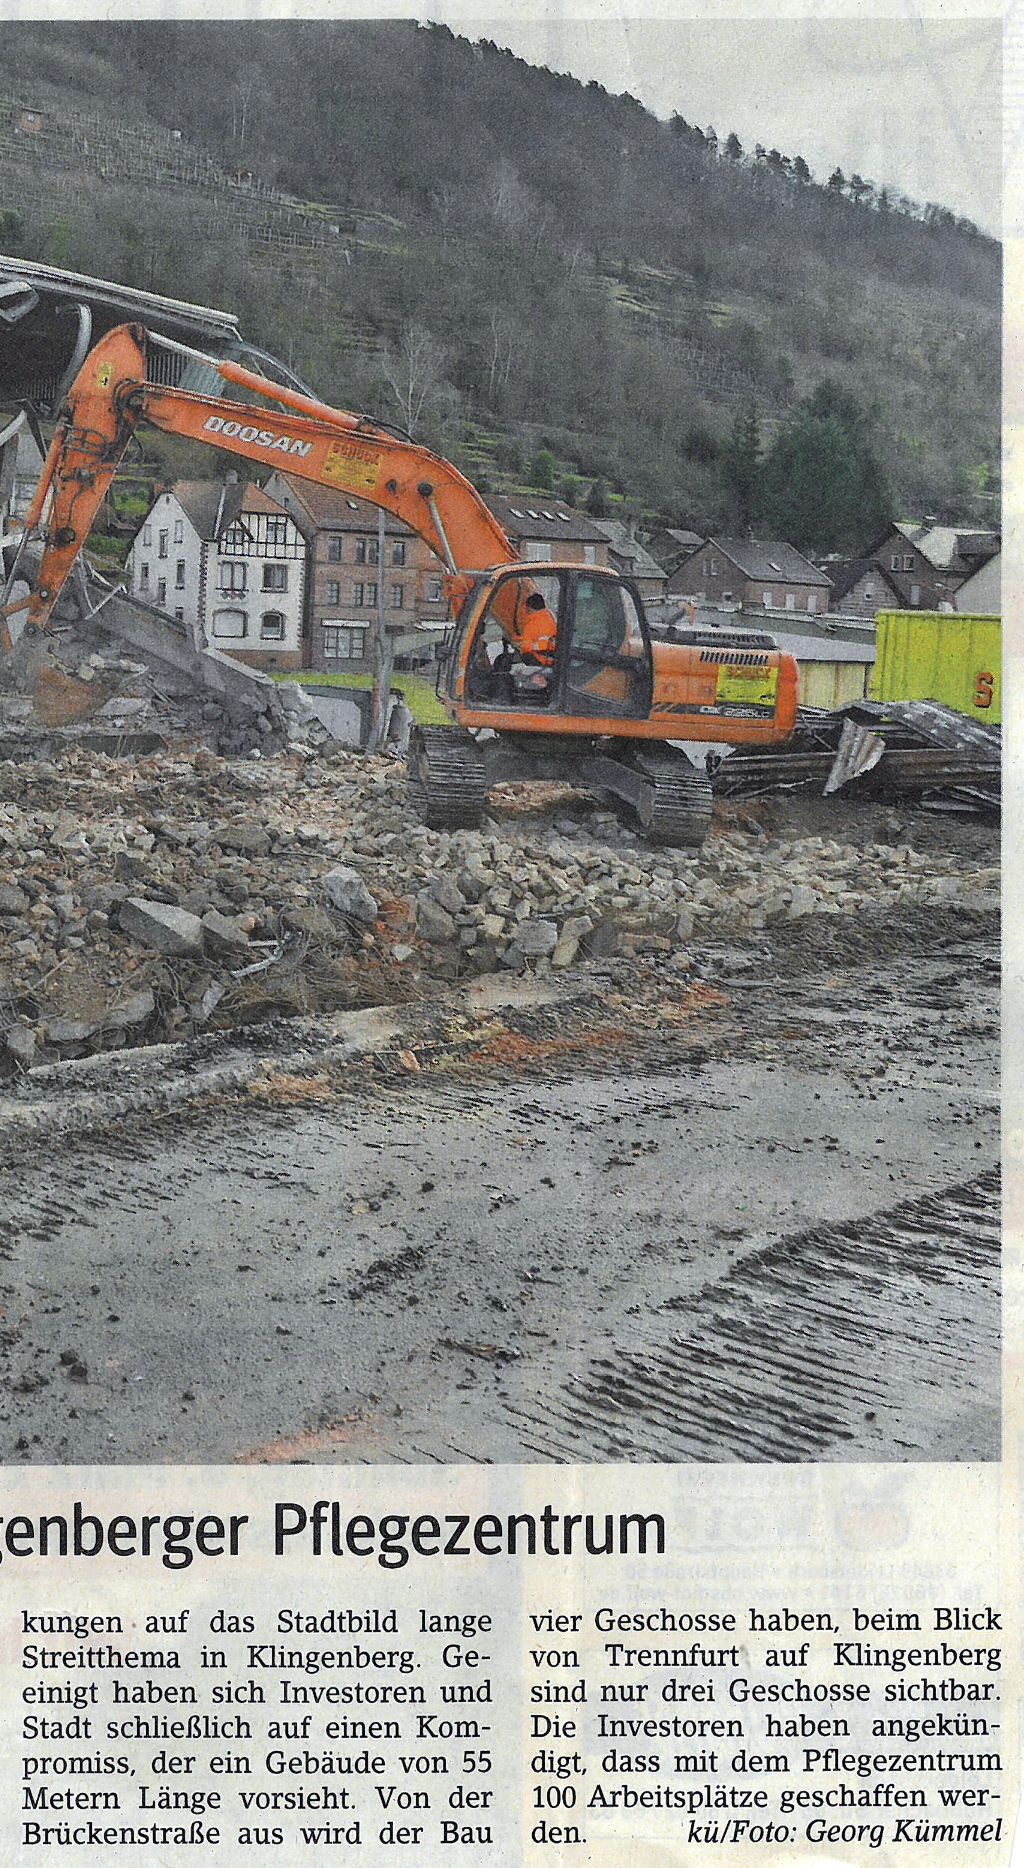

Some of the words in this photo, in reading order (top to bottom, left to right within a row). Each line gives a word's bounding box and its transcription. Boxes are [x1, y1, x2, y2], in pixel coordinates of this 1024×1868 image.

[203, 414, 314, 458] DOOSAN
[274, 1500, 665, 1570] Pflegezentrum
[21, 1609, 124, 1639] kungen
[145, 1609, 190, 1634] auf
[209, 1609, 255, 1634] das
[277, 1609, 399, 1634] Stadtbild
[419, 1609, 492, 1638] lange
[528, 1609, 583, 1633] vier
[594, 1607, 736, 1632] Geschosse
[748, 1607, 840, 1634] haben,
[852, 1607, 922, 1632] beim
[933, 1607, 1003, 1631] Blick
[22, 1644, 181, 1669] Streitthema
[200, 1645, 228, 1668] in
[246, 1645, 423, 1675] Klingenberg.
[442, 1643, 491, 1668] Ge-
[529, 1650, 580, 1668] von
[604, 1642, 740, 1667] Trennfurt
[765, 1642, 810, 1667] auf
[833, 1642, 1002, 1672] Klingenberg
[22, 1680, 99, 1710] einigt
[112, 1680, 198, 1704] haben
[212, 1679, 266, 1704] sich
[279, 1680, 427, 1704] Investoren
[439, 1679, 493, 1704] und
[530, 1679, 588, 1703] sind
[600, 1684, 649, 1702] nur
[661, 1678, 716, 1702] drei
[729, 1678, 871, 1703] Geschosse
[884, 1678, 1003, 1702] sichtbar.
[22, 1715, 92, 1740] Stadt
[107, 1714, 253, 1739] schließlich
[267, 1715, 312, 1739] auf
[325, 1715, 402, 1739] einen
[416, 1715, 491, 1739] Kom-
[530, 1714, 576, 1738] Die
[597, 1714, 745, 1738] Investoren
[765, 1713, 851, 1738] haben
[871, 1712, 1001, 1743] angekün-
[21, 1750, 136, 1781] promiss,
[151, 1750, 196, 1774] der
[209, 1750, 253, 1774] ein
[265, 1750, 386, 1775] Gebäude
[398, 1756, 449, 1774] von
[462, 1750, 492, 1774] 55
[530, 1749, 587, 1780] digt,
[601, 1748, 660, 1773] dass
[673, 1749, 719, 1773] mit
[731, 1749, 791, 1773] dem
[802, 1748, 1003, 1778] Pflegezentrum
[21, 1786, 121, 1810] Metern
[138, 1786, 221, 1815] Länge
[238, 1786, 358, 1810] vorsieht.
[374, 1786, 431, 1810] Von
[448, 1785, 493, 1809] der
[533, 1785, 577, 1809] 100
[586, 1784, 768, 1814] Arbeitsplätze
[779, 1783, 928, 1814] geschaffen
[937, 1789, 1001, 1807] wer-
[22, 1820, 220, 1846] Brückenstraße
[237, 1827, 284, 1845] aus
[299, 1821, 363, 1845] wird
[378, 1821, 424, 1845] der
[440, 1820, 494, 1844] Bau
[531, 1820, 589, 1844] den.
[687, 1819, 798, 1844] kü/Foto:
[805, 1818, 885, 1849] Georg
[891, 1817, 1003, 1843] Kümmel
